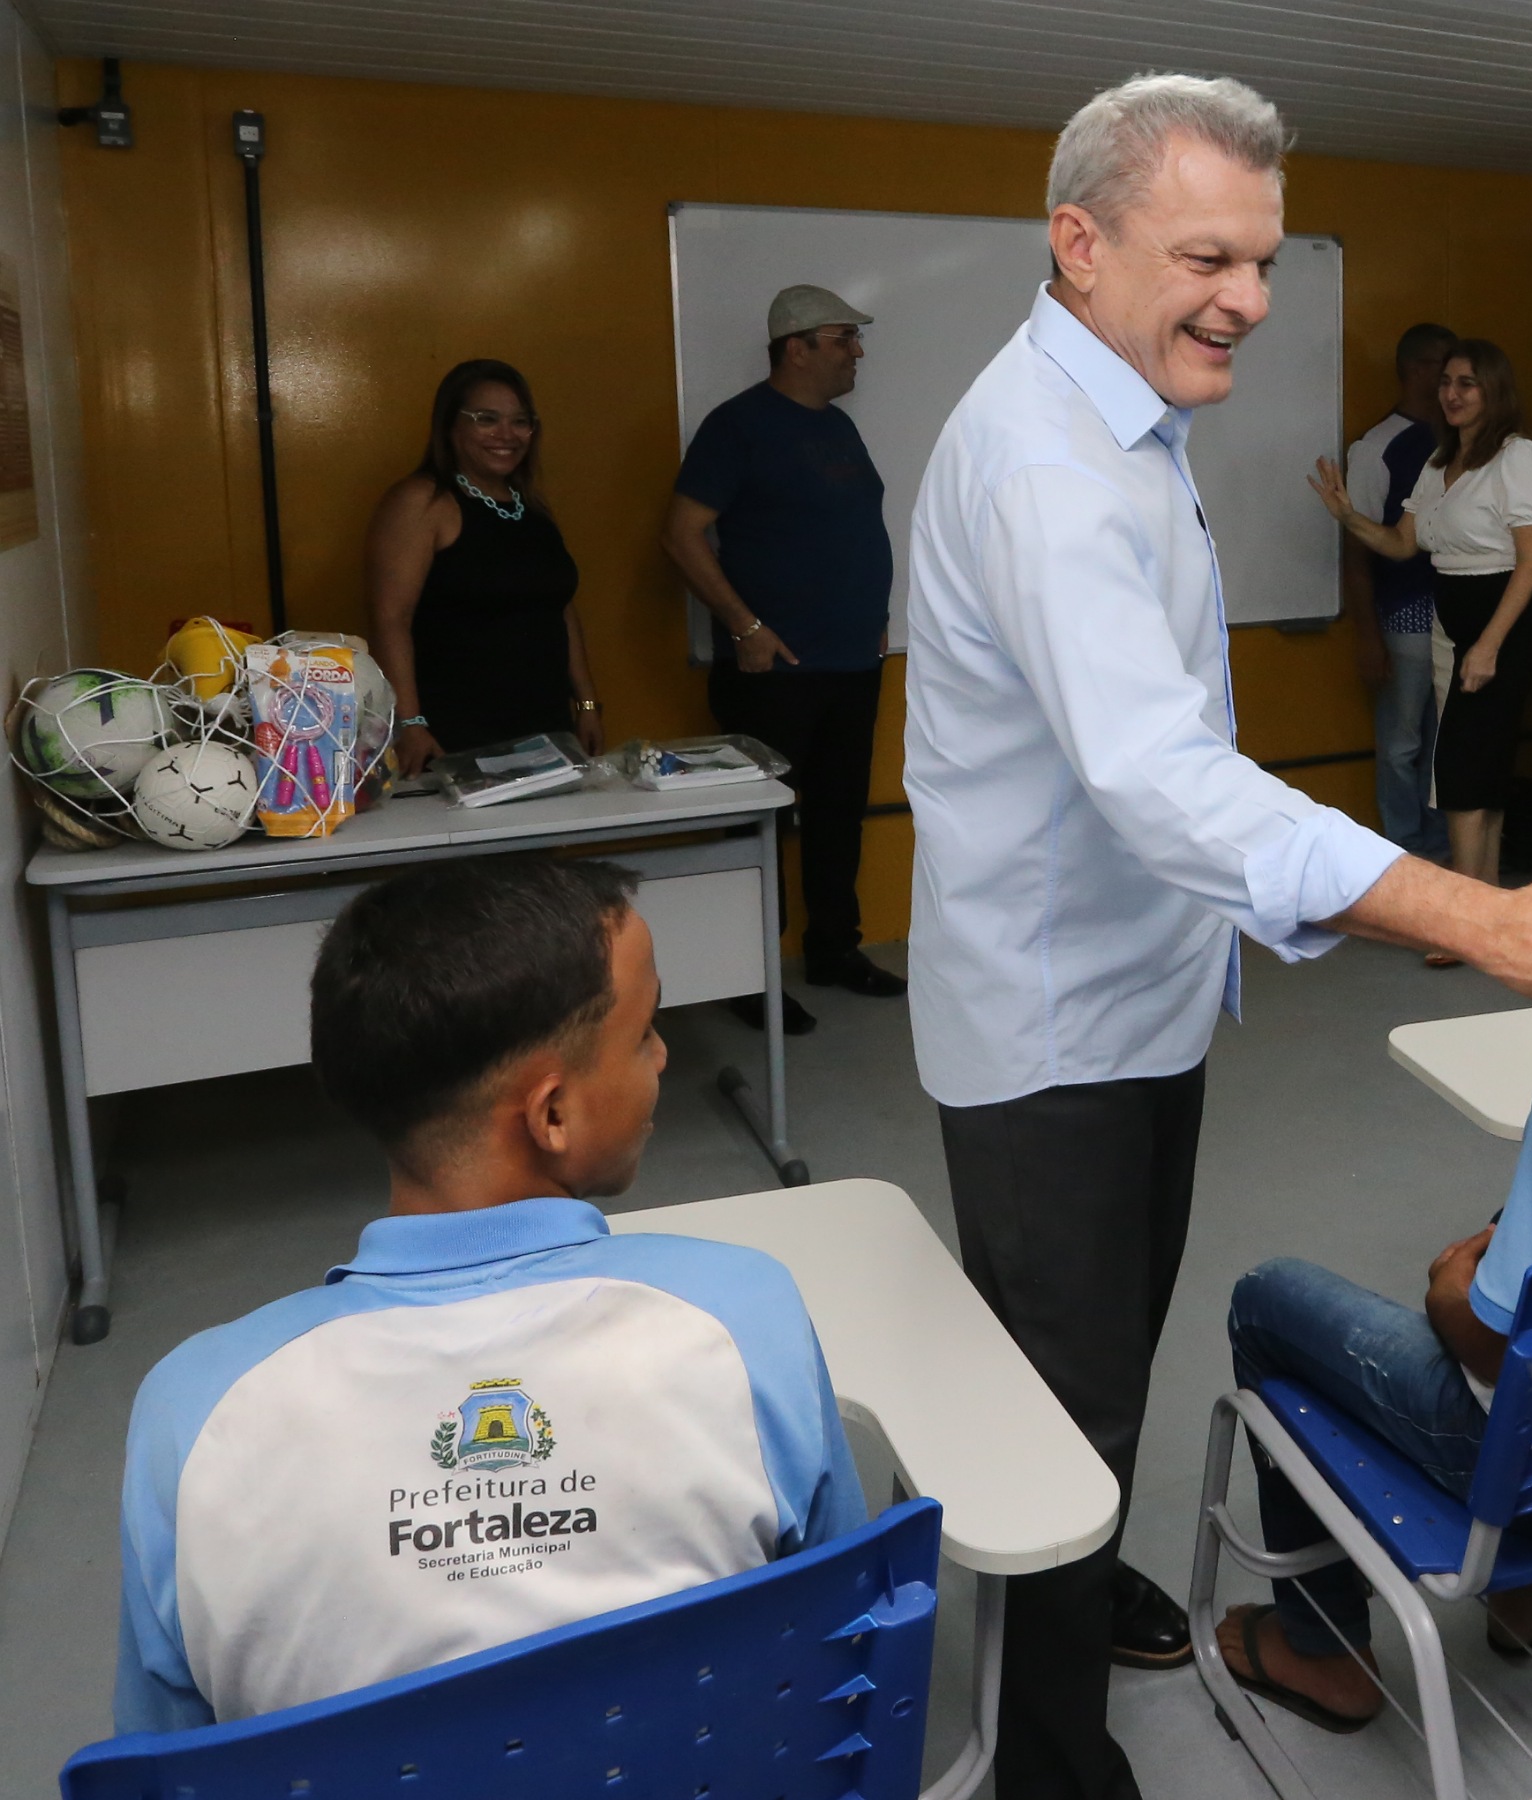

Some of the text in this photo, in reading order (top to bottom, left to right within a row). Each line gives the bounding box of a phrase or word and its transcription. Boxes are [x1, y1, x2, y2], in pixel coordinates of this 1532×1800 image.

[301, 669, 351, 682] CORDA
[463, 1451, 527, 1465] FORTITUDINE
[389, 1469, 597, 1512] Prefeitura de
[389, 1502, 597, 1556] Fortaleza
[418, 1540, 571, 1570] Secretaria Municipal
[447, 1559, 543, 1582] de Educação
